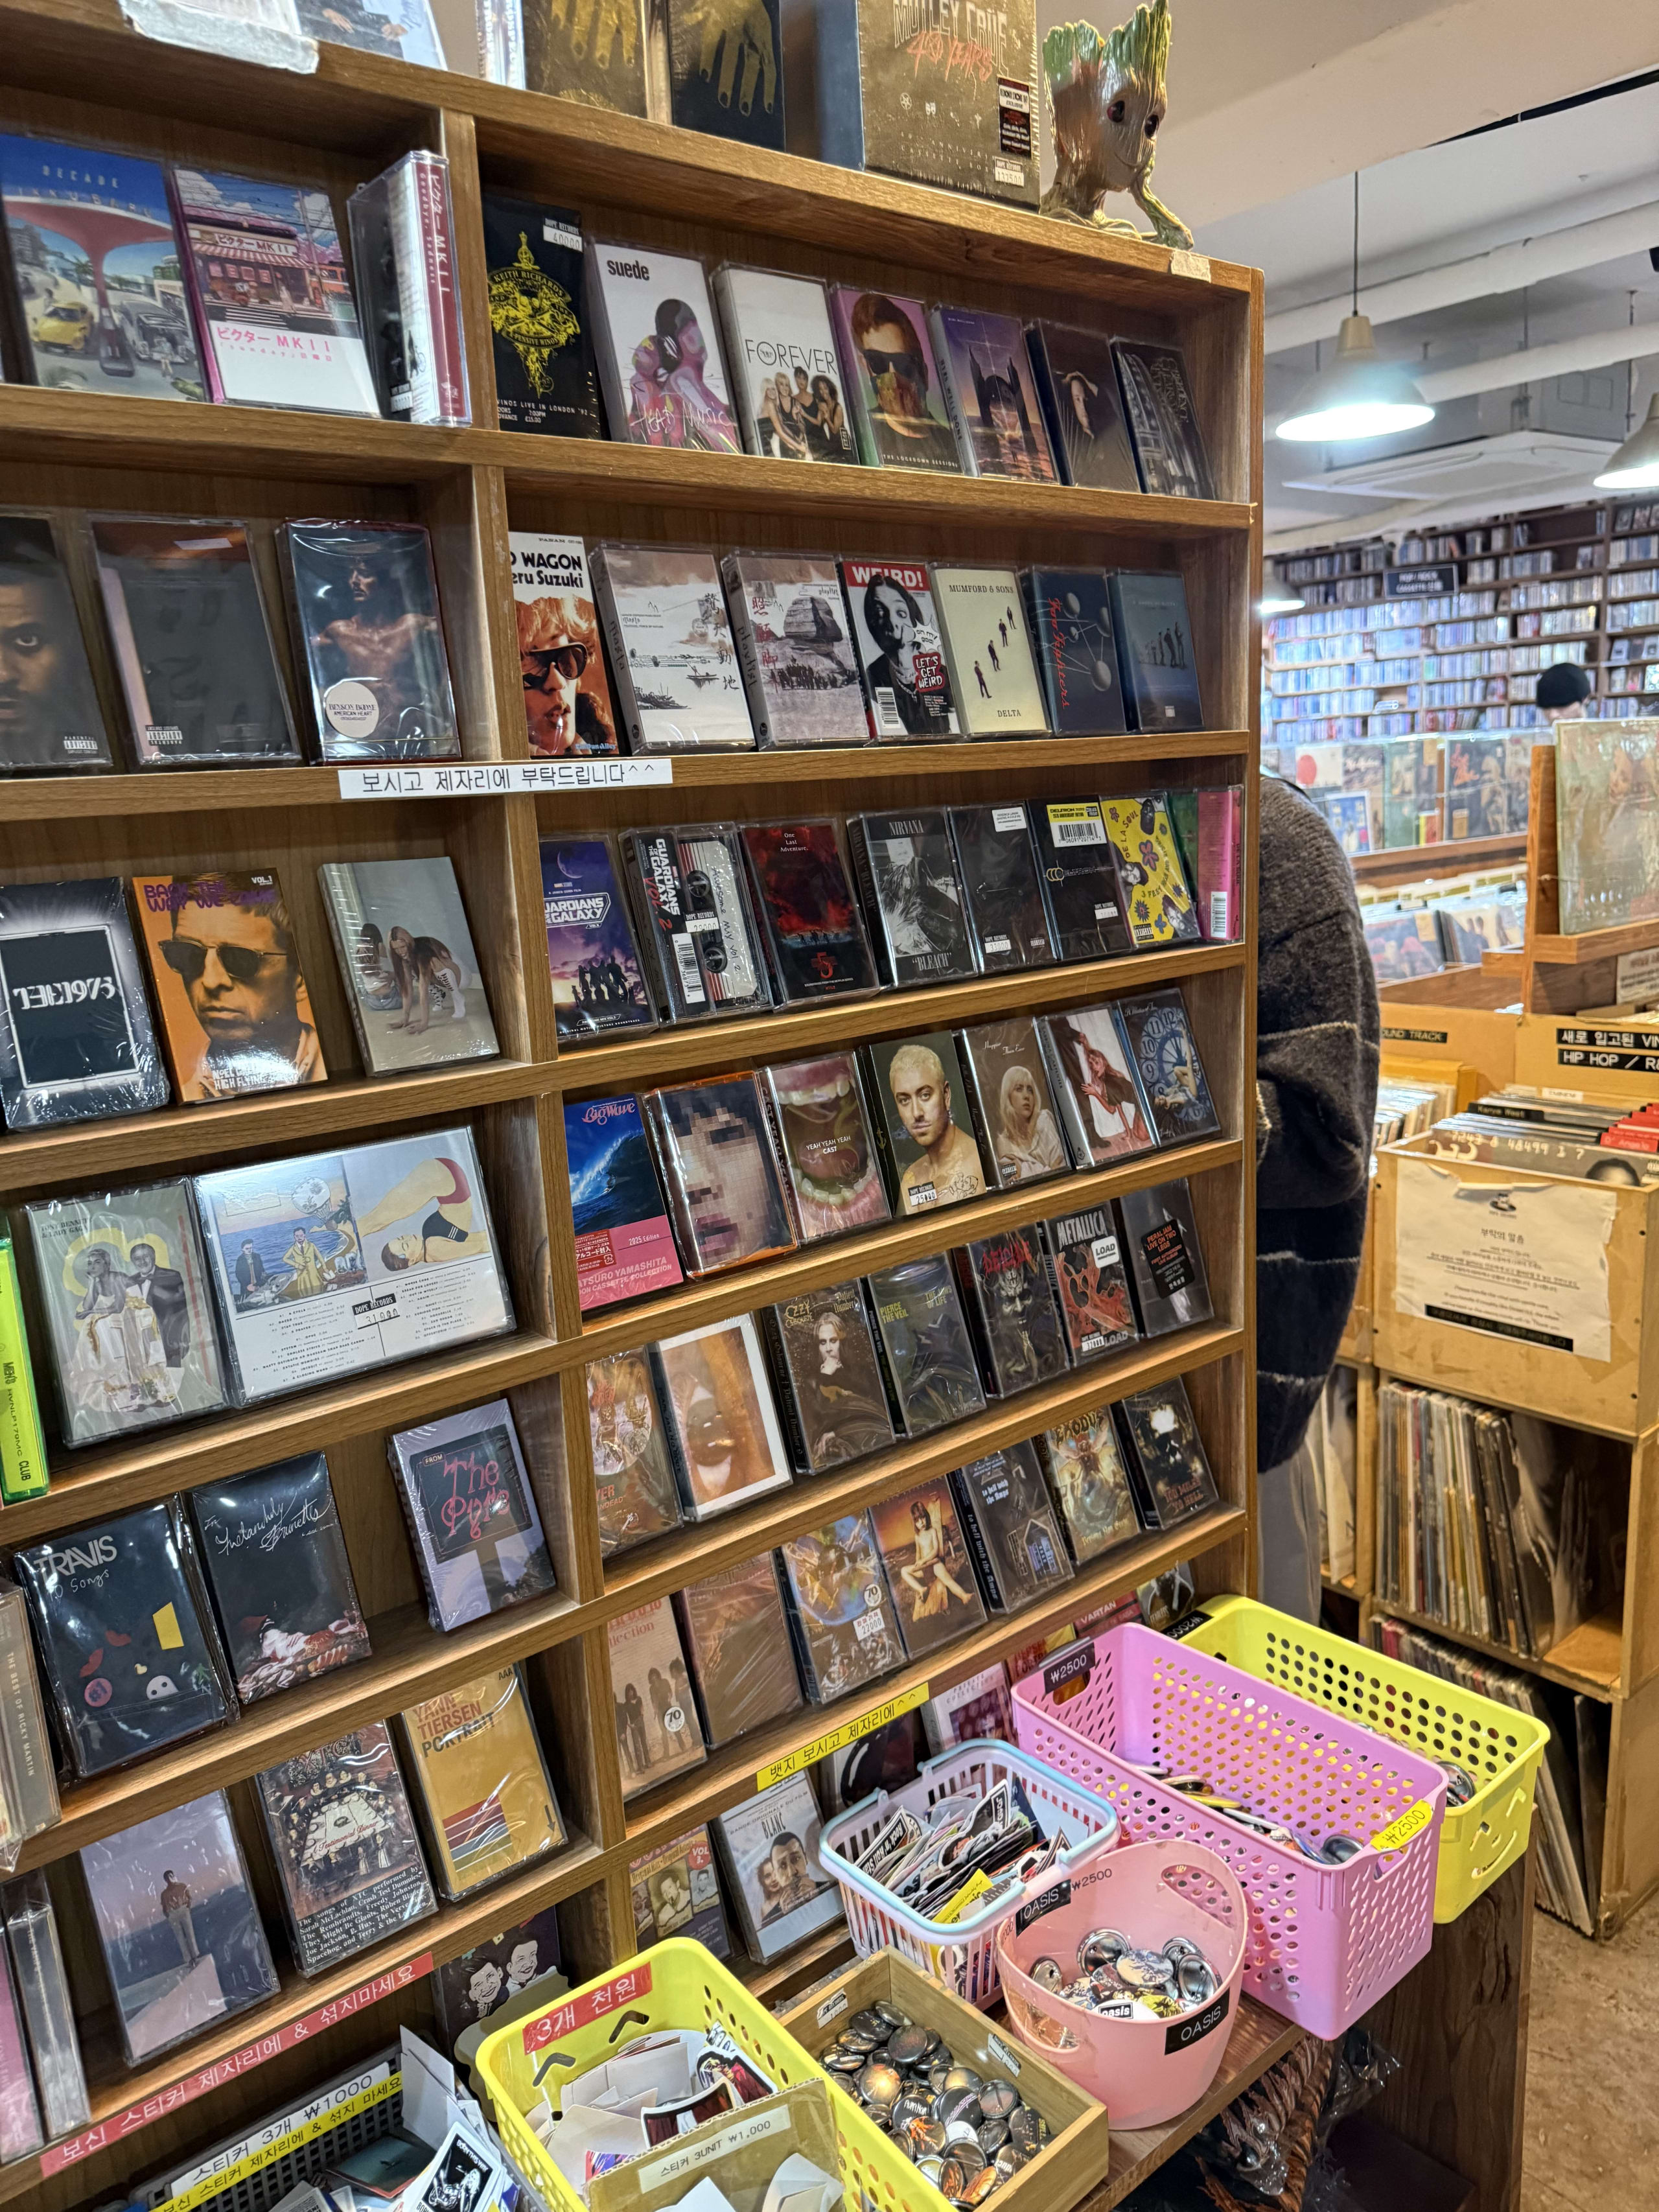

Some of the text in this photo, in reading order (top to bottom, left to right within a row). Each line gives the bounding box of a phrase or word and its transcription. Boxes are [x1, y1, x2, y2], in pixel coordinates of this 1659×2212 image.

[43, 165, 119, 189] DECADE
[553, 232, 581, 251] 40000
[607, 259, 650, 281] suede
[493, 270, 565, 298] KEITH RICHARDS
[745, 338, 837, 376] FOREVER
[520, 401, 575, 414] LIVE IN LONDON
[520, 551, 583, 572] WAGON
[537, 570, 584, 588] Suzuki
[852, 566, 924, 588] WEIRD!
[949, 585, 1014, 594] MUMFORD & SONS
[915, 655, 939, 668] LET'S
[920, 666, 937, 678] GET
[918, 675, 943, 689] WEIRD
[997, 709, 1022, 717] DELTA
[362, 771, 424, 793] 보시고
[435, 767, 511, 791] 제자리에
[888, 819, 924, 835] NIRVANA
[251, 875, 273, 885] VOL.1
[650, 856, 671, 914] GALAXY
[655, 838, 680, 916] GUARDIANS
[544, 897, 604, 913] UARDIANS
[550, 907, 603, 924] GALAXY
[658, 917, 673, 932] 2
[989, 942, 1010, 951] 33000
[817, 951, 833, 979] 5
[1150, 1021, 1161, 1035] 11
[1410, 1029, 1444, 1043] TRACK
[1561, 1030, 1634, 1048] 새로 입고된
[1141, 1038, 1155, 1054] 10
[1562, 1050, 1619, 1067] HIP HOP
[212, 1067, 235, 1080] NOEL
[1147, 1064, 1155, 1078] 9
[806, 1135, 852, 1152] YEAH YEAH YEAH
[822, 1145, 838, 1155] CAST
[628, 1233, 660, 1246] 2025 Edition
[1056, 1210, 1109, 1252] METALLICA
[1095, 1242, 1116, 1257] LOAD
[1146, 1240, 1159, 1252] LIVE
[614, 1256, 667, 1277] YAMASHITA
[592, 1264, 673, 1293] CASSETTE COLLECTION
[354, 1296, 393, 1314] DOPE RECORDS
[783, 1299, 811, 1320] OZZY
[879, 1301, 901, 1316] PIERCE
[882, 1308, 909, 1324] THE VEIL
[1104, 1331, 1129, 1347] LOAD
[1054, 1408, 1105, 1445] EXODUS
[424, 1454, 443, 1465] FROM
[18, 1460, 31, 1482] CLUB
[443, 1451, 500, 1496] The
[34, 1535, 118, 1583] TRAVIS
[70, 1569, 110, 1592] Songs
[864, 1585, 878, 1599] 70
[1080, 1600, 1117, 1624] VARTAN
[861, 1617, 882, 1635] 22000
[1049, 1653, 1087, 1684] ₩2500
[6, 1651, 34, 1777] THE BEST OF RICKY MARTIN
[412, 1693, 456, 1724] YANN
[666, 1708, 681, 1721] 70
[417, 1701, 483, 1741] TIERSEN
[769, 1754, 796, 1782] 뱃지
[802, 1732, 842, 1764] 보시고
[319, 1821, 379, 1852] Testimonial Dinner
[761, 1811, 787, 1841] BLANC
[1386, 1810, 1426, 1845] ₩2500
[692, 1846, 710, 1856] VOL
[873, 1821, 904, 1867] Rock Roll
[1071, 1867, 1113, 1892] ₩2500
[297, 1866, 419, 1927] The songs XTC performed by
[1023, 1887, 1060, 1919] OASIS
[299, 1922, 319, 1935] Sarah
[320, 1904, 358, 1925] McLachlan,
[358, 1892, 378, 1907] Crash
[378, 1887, 391, 1899] Test
[301, 1897, 389, 1942] The Rembrandts, Freedy
[303, 1898, 402, 1950] They Might Be Giants, Ruben
[305, 1948, 318, 1958] Joe
[319, 1933, 349, 1952] Jackson,
[375, 1912, 390, 1922] The
[307, 1915, 398, 1965] Spacehog, and Terry the
[535, 1973, 638, 2043] 3개 천원
[1101, 2005, 1130, 2018] oasis
[1179, 2005, 1222, 2042] OASIS
[62, 1962, 417, 2166] 보신 스티커 제자리에 & 섞지마세요
[192, 2073, 374, 2184] 스티커 3개 ₩1000
[199, 2167, 242, 2196] 스티커
[250, 2129, 305, 2169] 제자리에
[311, 2121, 323, 2134] &
[362, 2075, 402, 2104] 마세요
[660, 2158, 691, 2178] 스티커
[693, 2139, 724, 2161] 3UNIT
